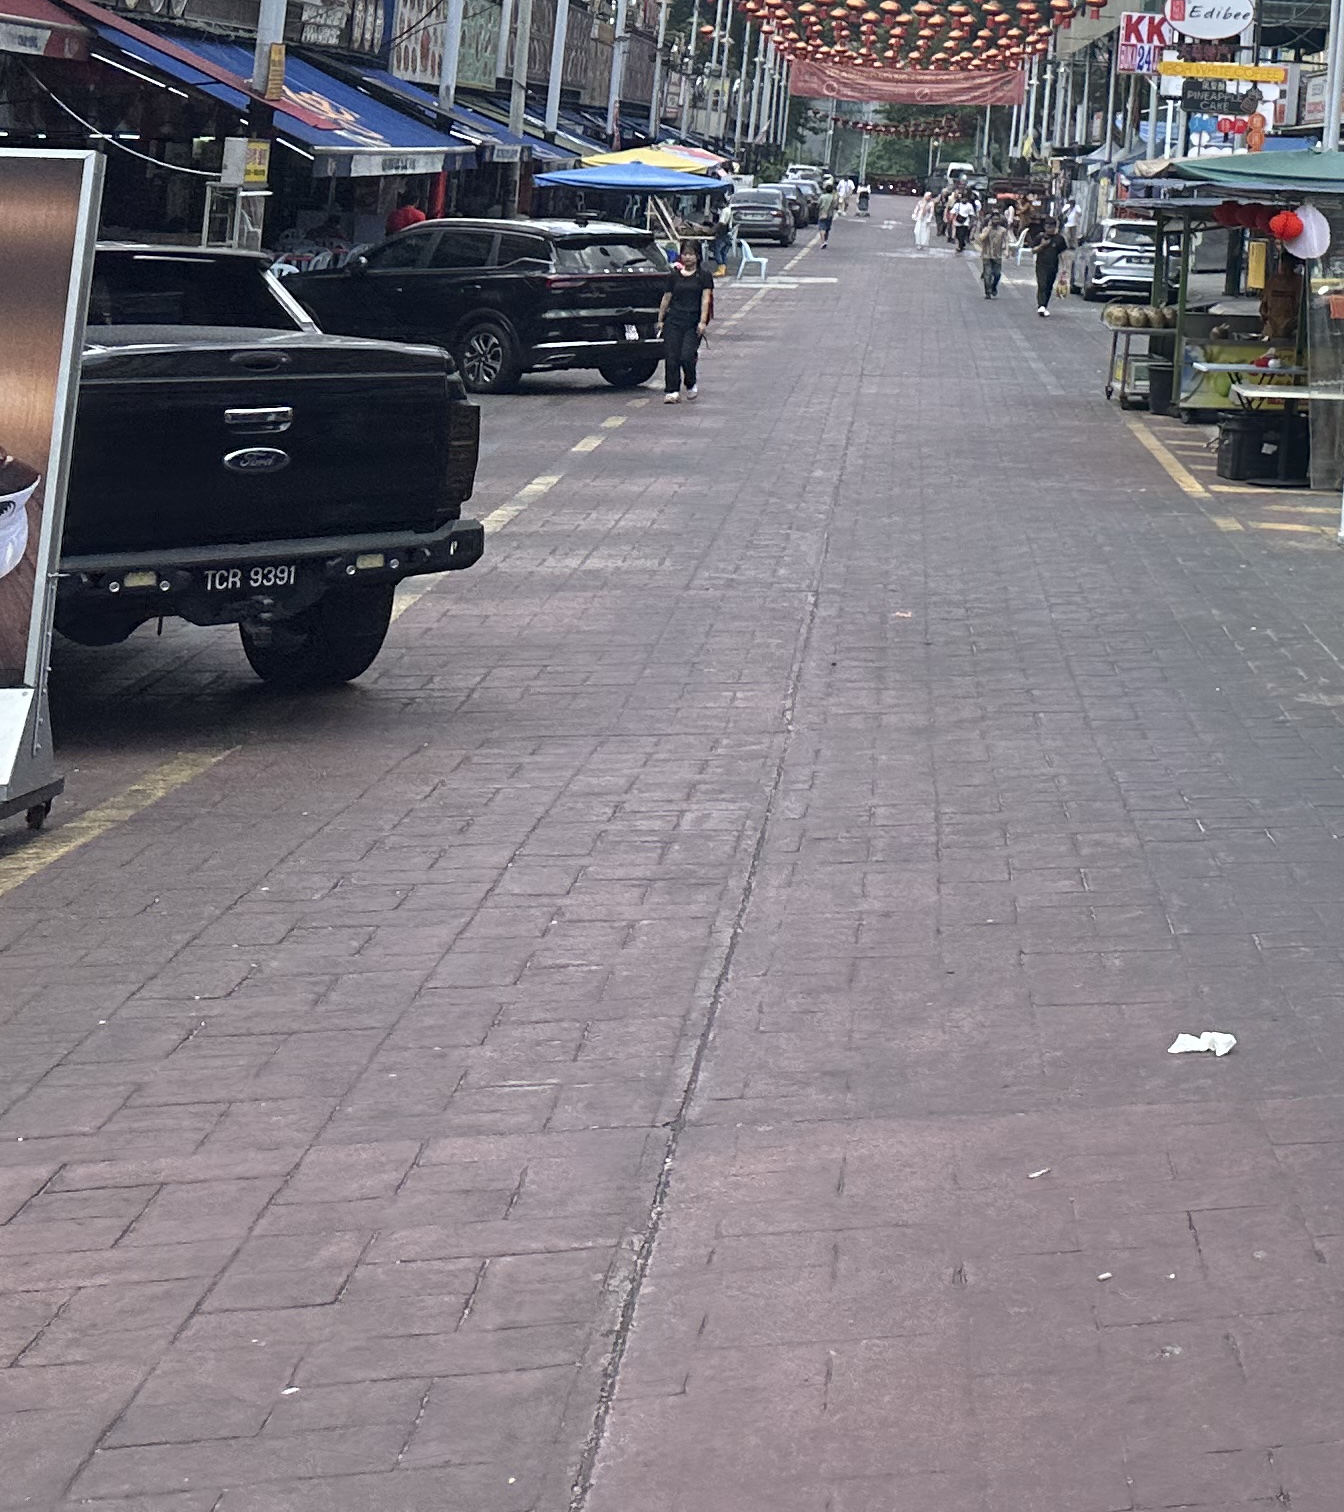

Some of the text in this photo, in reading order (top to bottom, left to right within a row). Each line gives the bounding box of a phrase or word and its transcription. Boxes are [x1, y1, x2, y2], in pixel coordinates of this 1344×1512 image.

[1188, 4, 1252, 20] Edibee
[1124, 14, 1167, 45] KK
[1233, 65, 1284, 80] COFFEE
[1199, 101, 1229, 111] CAKE
[204, 564, 297, 591] TCR 9391
